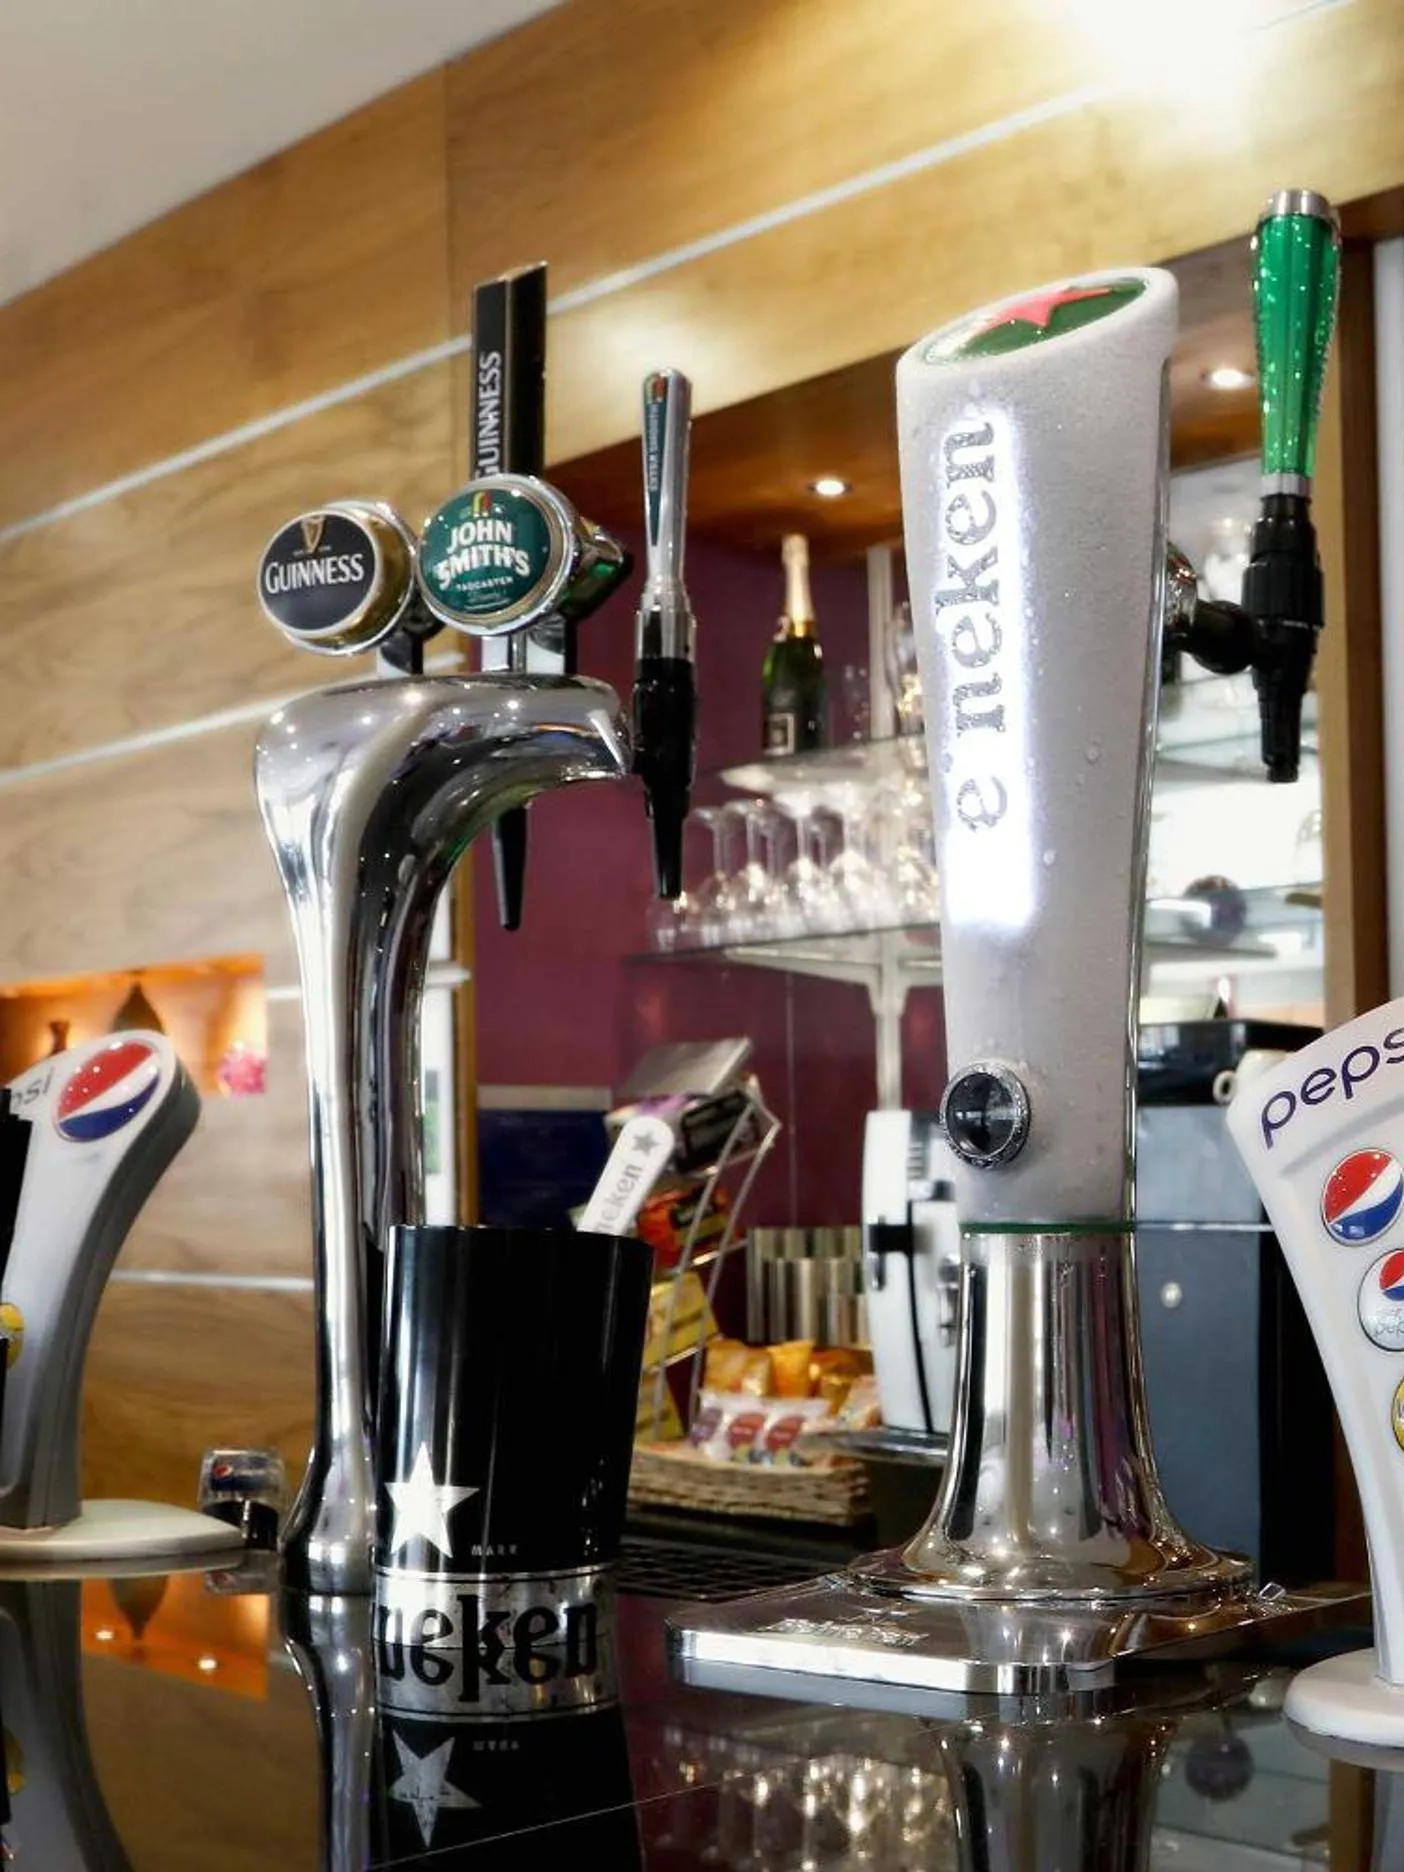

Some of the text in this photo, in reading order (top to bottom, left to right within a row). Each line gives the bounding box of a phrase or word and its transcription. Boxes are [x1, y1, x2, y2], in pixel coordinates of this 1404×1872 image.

[446, 519, 513, 553] JOHN
[265, 553, 365, 594] GUINNESS
[432, 545, 531, 591] SMITH'S
